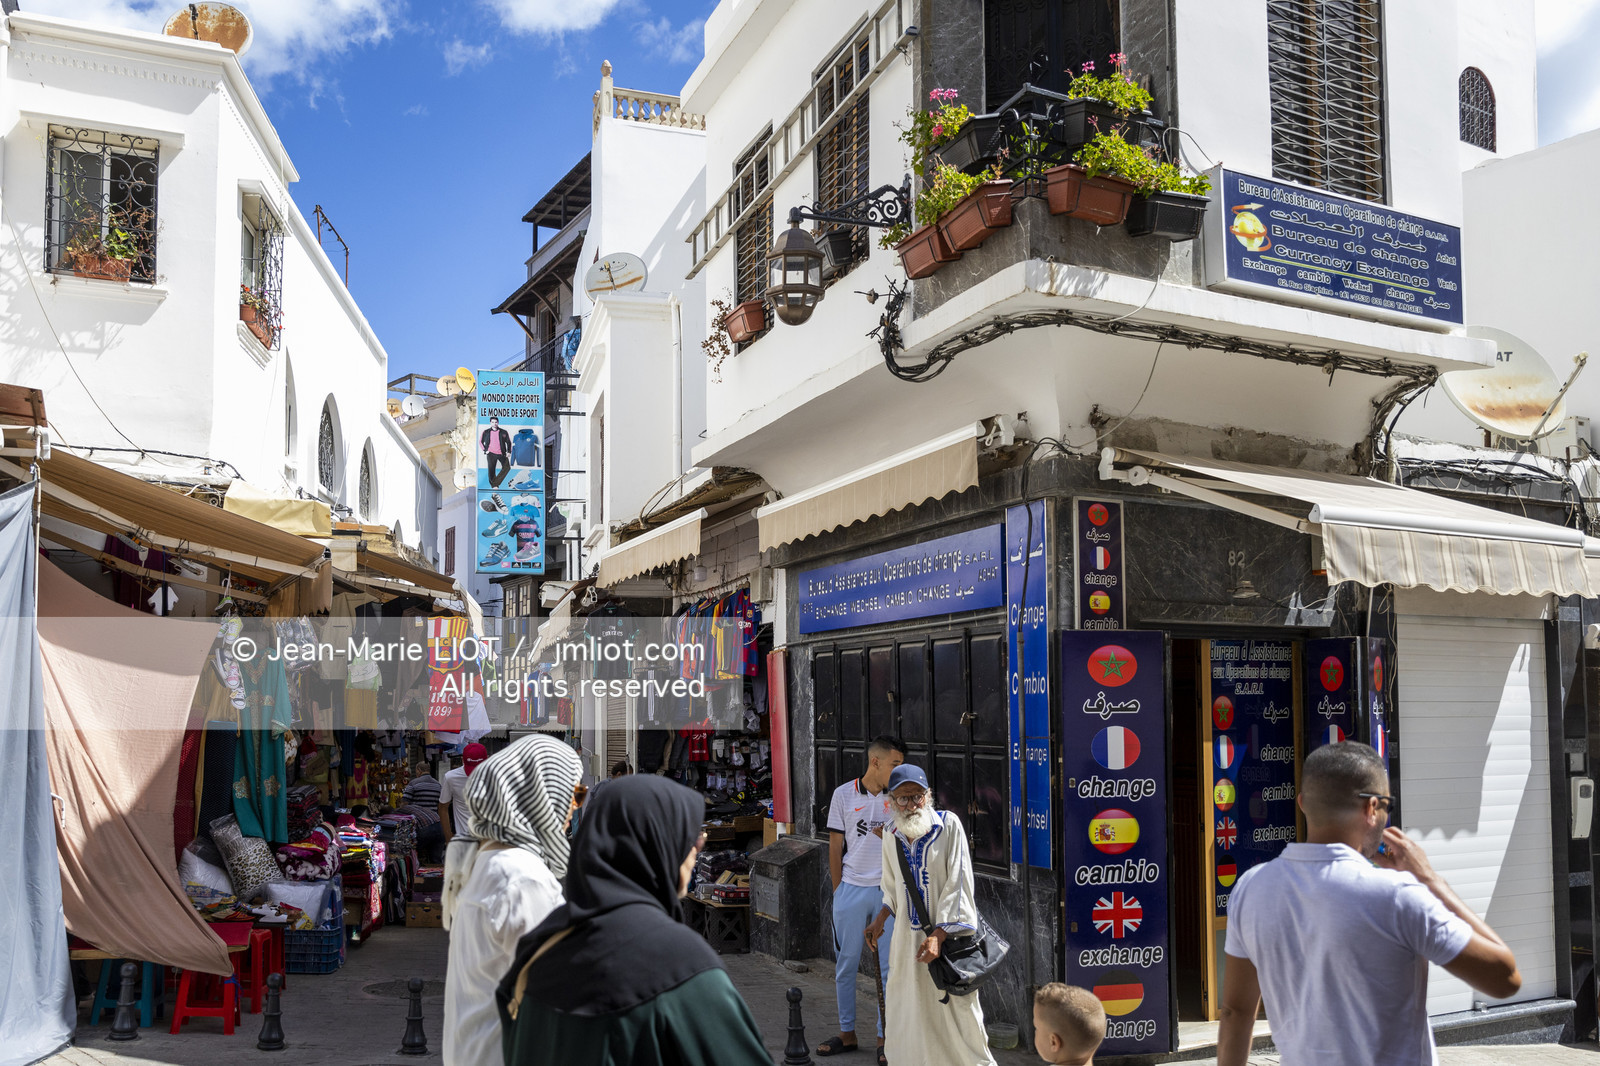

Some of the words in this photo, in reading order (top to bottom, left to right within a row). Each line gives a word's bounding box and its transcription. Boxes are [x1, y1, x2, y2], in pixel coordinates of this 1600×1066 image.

[1239, 179, 1270, 199] Bureau
[1271, 187, 1324, 211] d'Assistance
[1326, 202, 1342, 216] aux
[1343, 204, 1385, 226] Operations
[1386, 214, 1396, 229] de
[1397, 218, 1424, 237] change
[1270, 209, 1364, 238] العملات
[1271, 224, 1339, 249] Bureau
[1343, 241, 1366, 254] de
[1371, 248, 1429, 269] change
[1372, 232, 1426, 252] صرف
[1274, 245, 1352, 271] Currency
[1356, 260, 1429, 287] Exchange
[1436, 252, 1457, 266] Achat
[1242, 257, 1287, 276] Exchange
[1297, 269, 1331, 284] cambio
[1342, 277, 1373, 293] Wechsel
[1386, 287, 1415, 302] change
[1437, 277, 1457, 291] Vente
[1289, 280, 1303, 290] Rue
[1396, 301, 1423, 314] TANGER
[1423, 296, 1450, 309] صرف
[1496, 351, 1513, 362] AT
[516, 377, 539, 388] العالم
[482, 393, 506, 403] MONDO
[507, 394, 514, 403] DE
[515, 394, 540, 404] DEPORTE
[481, 408, 487, 417] LE
[488, 408, 510, 417] MONDE
[511, 408, 518, 418] DE
[520, 408, 538, 418] SPORT
[1086, 527, 1110, 543] صرف
[869, 568, 881, 585] aux
[883, 557, 920, 584] Operations
[922, 553, 932, 574] de
[934, 549, 962, 573] change
[1228, 550, 1245, 568] 82
[978, 566, 998, 582] ACHAT
[1084, 572, 1117, 588] change
[955, 580, 975, 600] صرف
[816, 602, 847, 619] EXCHANGE
[850, 596, 882, 613] WECHSEL
[885, 590, 913, 608] CAMBIO
[917, 583, 951, 602] CHANGE
[1084, 617, 1119, 630] cambio
[1210, 639, 1240, 661] Bureau
[1213, 667, 1225, 679] aux
[1225, 662, 1259, 682] Operations
[1260, 662, 1268, 679] de
[1269, 662, 1290, 682] change
[1012, 671, 1046, 695] Cmbio
[429, 686, 464, 705] ince
[1083, 691, 1140, 720] صرف
[1263, 700, 1290, 724] صرف
[1317, 695, 1346, 720] صرف
[1261, 744, 1295, 764] change
[1078, 776, 1156, 802] change
[1262, 783, 1296, 801] cambio
[1013, 805, 1049, 830] Wchsel
[1253, 824, 1296, 842] exchange
[1075, 858, 1159, 886] cambio
[1079, 944, 1164, 968] exchange
[1104, 1018, 1157, 1041] hange
